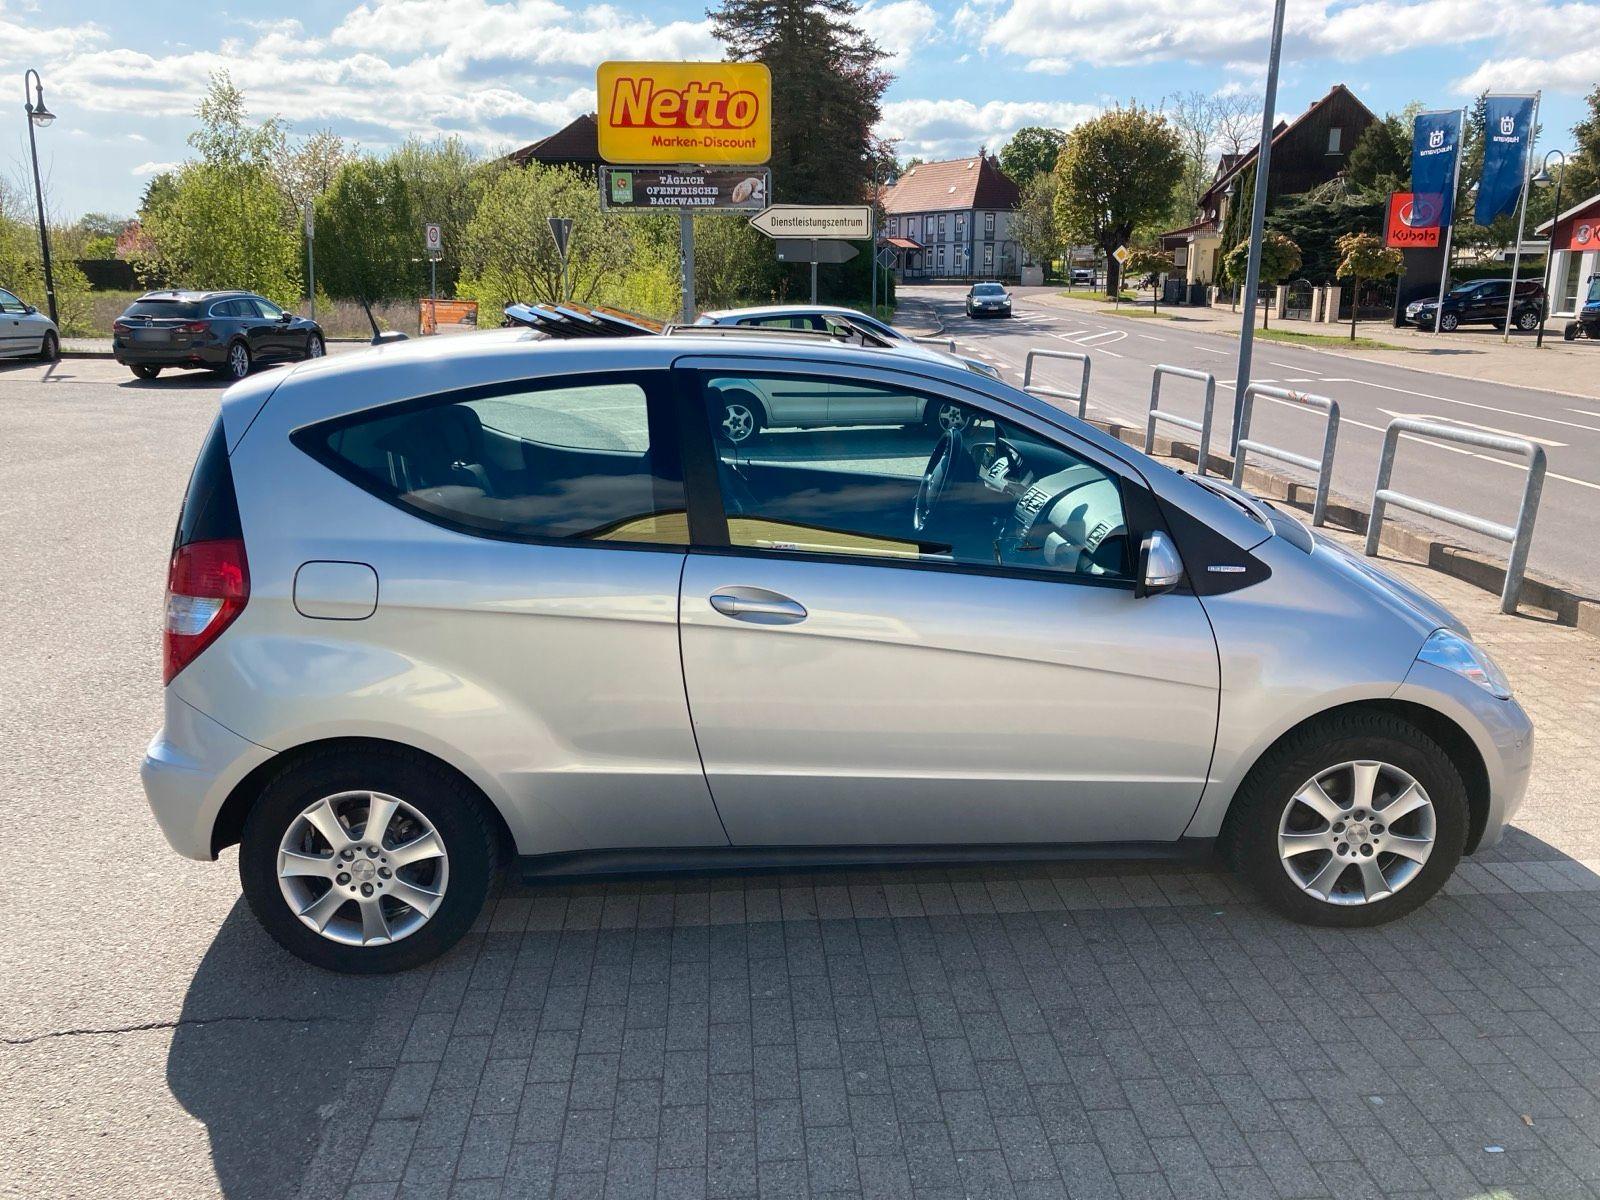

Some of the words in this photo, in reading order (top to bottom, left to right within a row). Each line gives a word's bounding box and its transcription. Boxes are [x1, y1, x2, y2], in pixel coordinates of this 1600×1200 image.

[610, 77, 759, 129] Netto
[651, 135, 757, 149] Marken-Discount
[659, 174, 705, 185] TÄGLICH
[646, 186, 719, 195] OFENFRISCHE
[650, 197, 716, 205] BACKWAREN
[771, 216, 863, 229] Dienstleistungszentrum
[1392, 229, 1437, 241] Kubota
